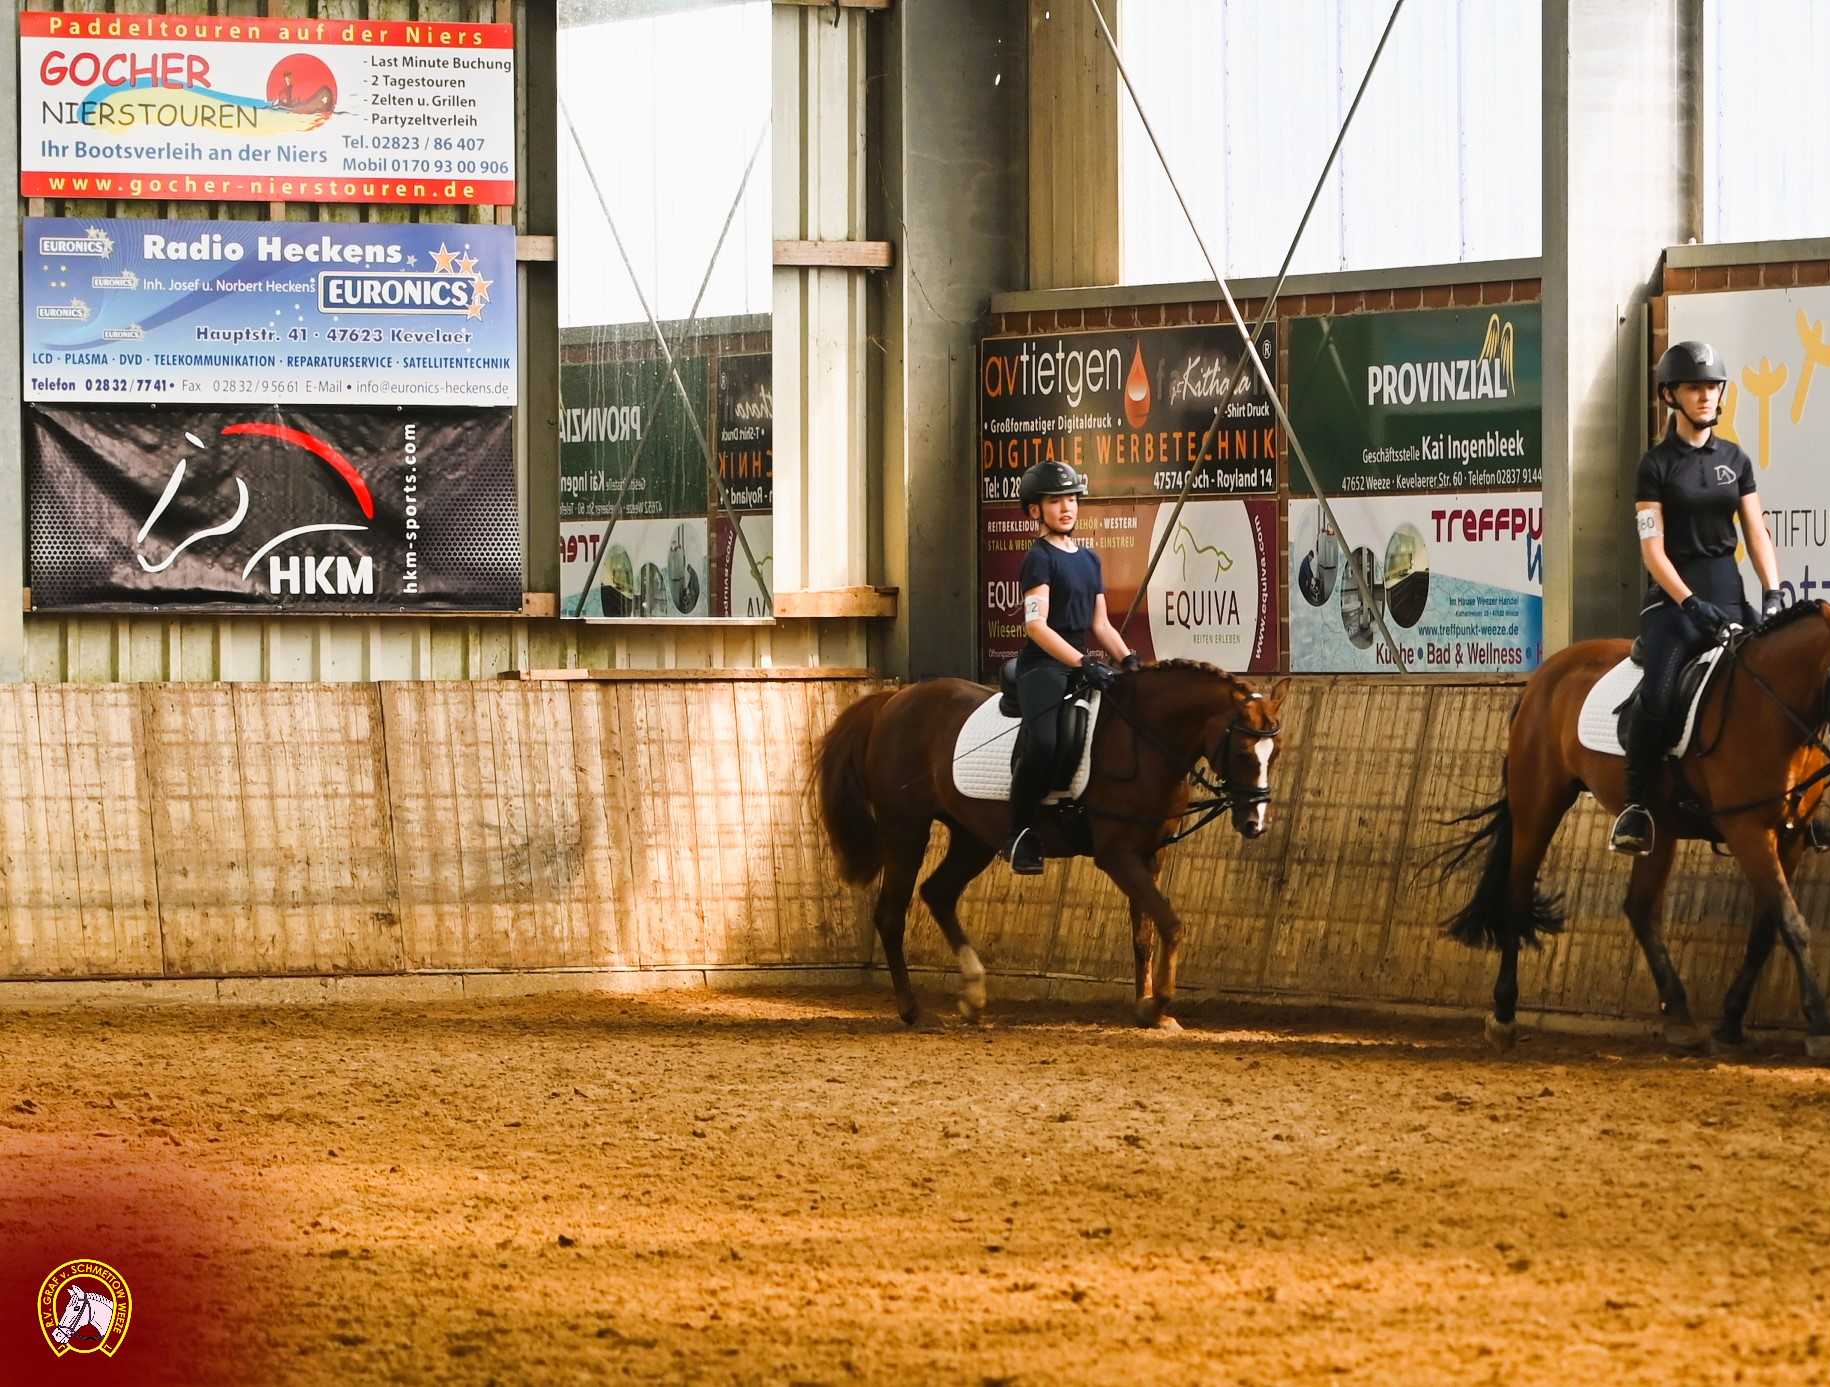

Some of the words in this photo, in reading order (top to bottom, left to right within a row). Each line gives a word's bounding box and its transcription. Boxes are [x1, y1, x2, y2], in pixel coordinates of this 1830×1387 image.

[49, 16, 261, 41] Paddeltouren
[279, 23, 326, 42] auf
[341, 24, 388, 43] der
[406, 25, 483, 45] Niers
[40, 50, 210, 89] GOCHER
[371, 55, 398, 69] Last
[402, 56, 449, 70] Minute
[453, 57, 512, 73] Buchung
[371, 75, 380, 88] 2
[383, 75, 466, 91] Tagestouren
[371, 93, 412, 107] Zelten
[431, 95, 476, 108] Grillen
[42, 100, 258, 129] NIERSTOUREN
[371, 113, 478, 129] Partyzeltverleih
[41, 141, 70, 158] Ihr
[75, 141, 203, 160] Bootsverleih
[209, 146, 233, 161] an
[238, 144, 271, 162] der
[276, 144, 328, 163] Niers
[342, 135, 369, 150] Tel.
[372, 136, 421, 150] 02823
[456, 137, 485, 152] 407
[343, 157, 387, 172] Mobil
[392, 159, 433, 173] 0170
[481, 160, 509, 175] 906
[49, 176, 475, 199] www.gocher-nierstouren.de
[43, 240, 104, 253] EURONICS
[143, 234, 244, 261] Radio
[258, 236, 402, 263] Heckens
[143, 279, 166, 290] Inh.
[168, 280, 199, 291] Josef
[216, 280, 262, 292] Norbert
[266, 280, 315, 293] Heckens
[329, 279, 468, 307] EURONICS
[196, 327, 280, 344] Hauptstr.
[288, 329, 307, 342] 41
[327, 329, 383, 342] 47623
[391, 329, 472, 343] Kevelaer
[32, 352, 52, 365] LCD
[64, 353, 108, 366] PLASMA
[119, 354, 143, 366] DVD
[154, 354, 275, 367] TELEKOMMUNIKATION
[287, 356, 392, 368] REPARATURSERVICE
[403, 357, 510, 369] SATELLITENTECHNIK
[985, 340, 1122, 408] avtietgen
[1181, 356, 1251, 401] Kithaa
[1368, 358, 1508, 405] PROVINZIAL
[31, 378, 76, 391] Telefon
[182, 379, 201, 392] Fax
[306, 381, 342, 393] E-Mail
[357, 381, 509, 394] info@euronics-heckens.de
[1247, 402, 1270, 417] Druck
[990, 419, 1055, 435] Großformatiger
[1057, 417, 1112, 434] Digitaldruck
[983, 435, 1083, 469] DIGITALE
[1362, 446, 1420, 464] Geschäftsstelle
[1422, 434, 1444, 459] Kai
[1448, 430, 1525, 465] Ingenbleek
[1154, 471, 1182, 489] 47574
[1216, 469, 1257, 492] Royland
[1341, 476, 1366, 490] 47652
[1366, 475, 1390, 490] Weeze
[1396, 471, 1438, 489] Kevelaerer
[1468, 469, 1495, 484] Telefon
[1496, 468, 1520, 484] 02837
[1522, 468, 1542, 483] 9144
[402, 423, 419, 594] hkm-sports.com
[988, 520, 1039, 533] REITBEKLEIDUN
[1103, 516, 1137, 529] WESTERN
[269, 555, 374, 594] HKM
[1255, 514, 1269, 660] www.equiva.com
[1165, 590, 1241, 629] EQUIVA
[1418, 623, 1519, 640] www.treffpunkt-weeze.de
[1427, 643, 1450, 664] Bad
[1467, 642, 1522, 664] Wellness
